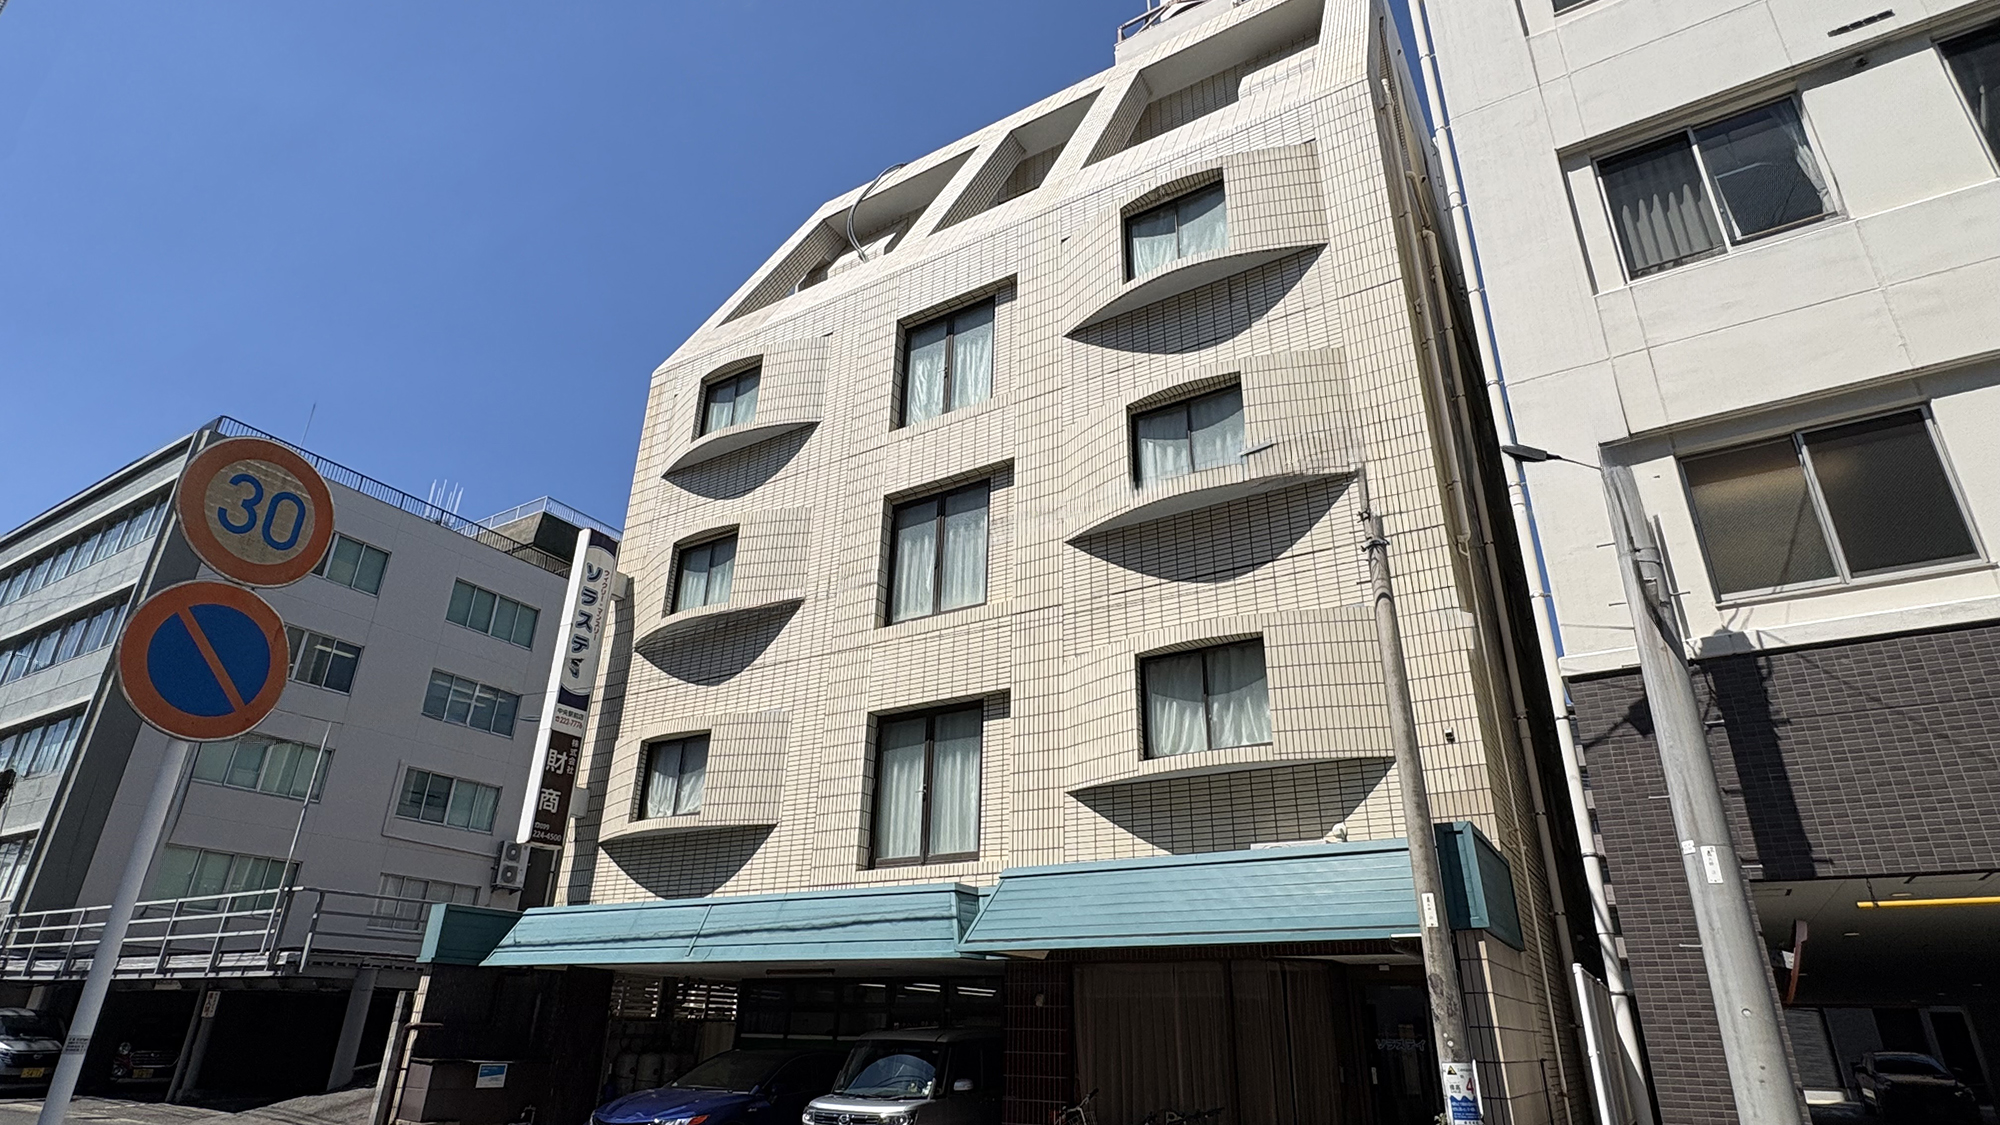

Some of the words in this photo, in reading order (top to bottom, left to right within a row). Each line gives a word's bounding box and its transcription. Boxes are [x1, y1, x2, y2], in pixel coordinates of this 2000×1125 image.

[217, 473, 306, 551] 30
[566, 738, 580, 775] 株式会社
